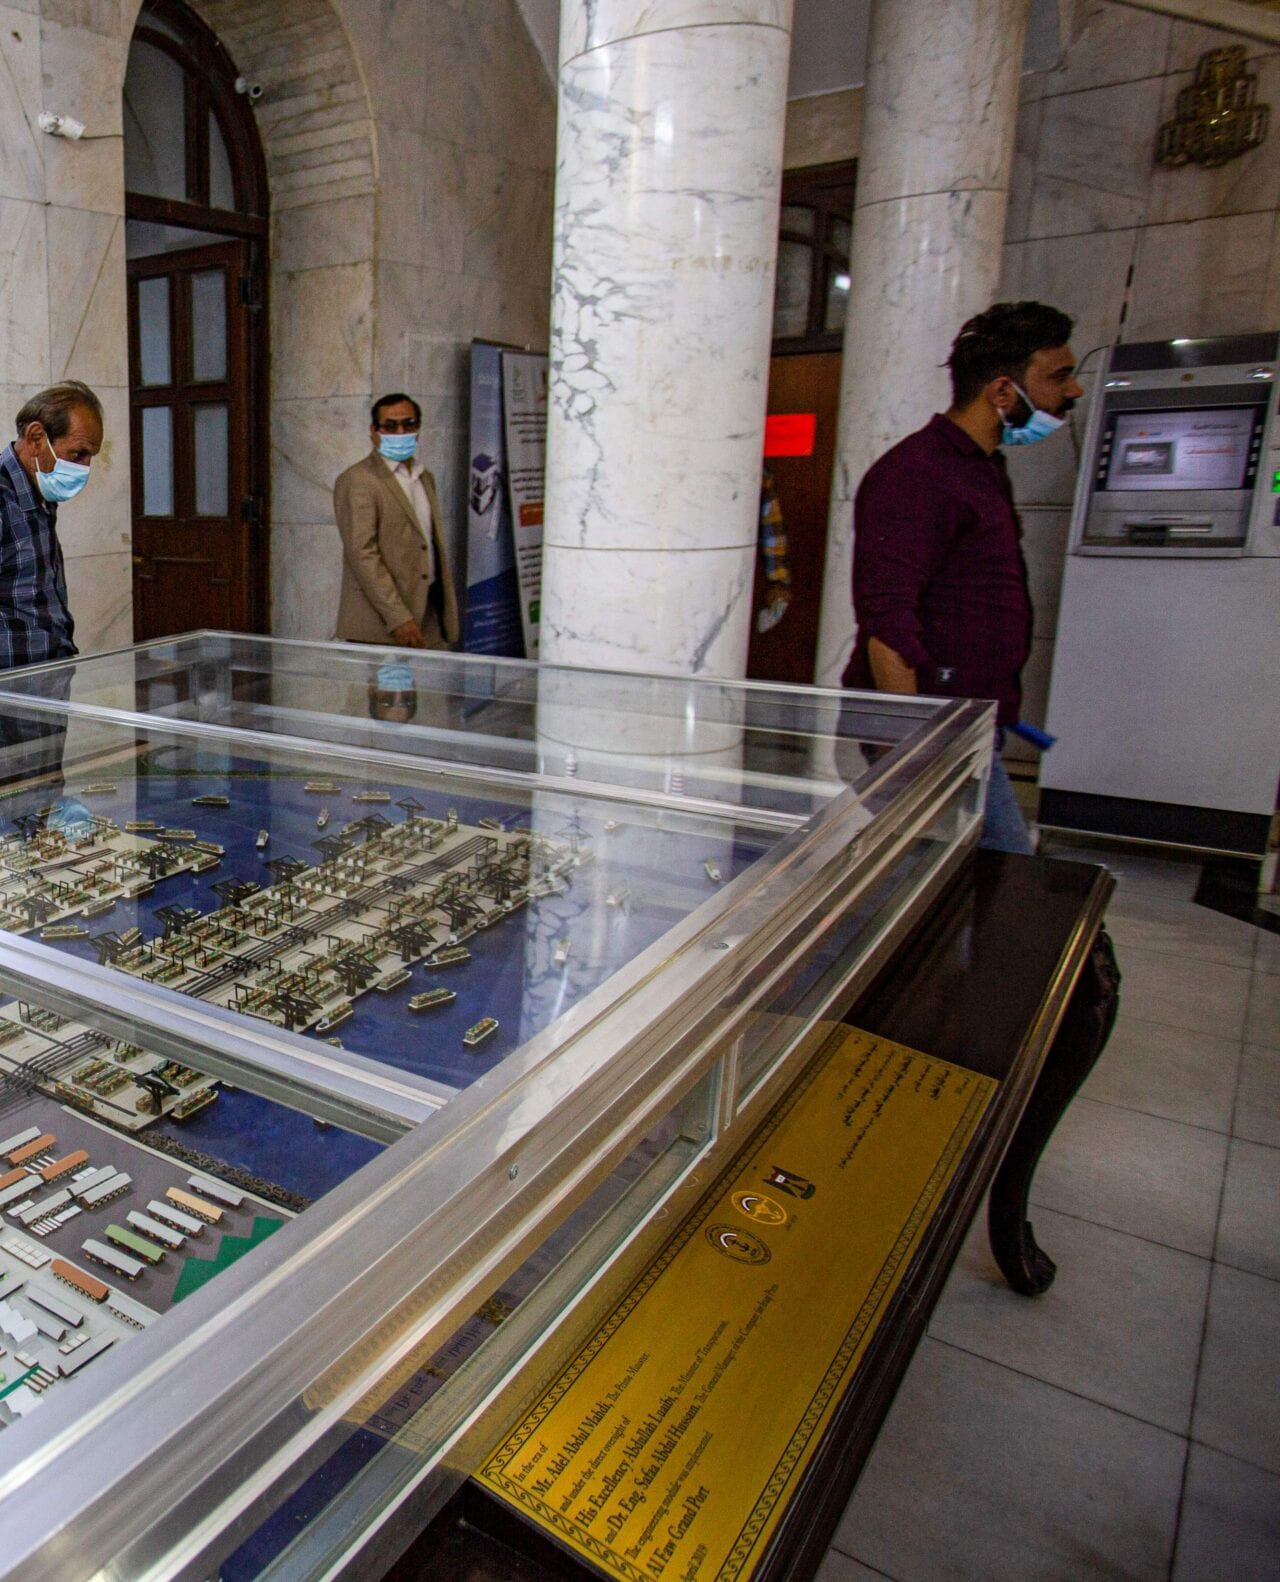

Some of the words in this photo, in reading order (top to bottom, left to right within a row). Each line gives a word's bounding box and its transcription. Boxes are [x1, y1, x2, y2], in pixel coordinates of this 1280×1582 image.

[512, 1472, 527, 1483] In
[521, 1461, 535, 1474] the
[531, 1451, 543, 1464] era
[538, 1441, 549, 1454] of
[531, 1478, 554, 1498] Mr.
[546, 1453, 571, 1480] Adel
[562, 1426, 591, 1459] Abdul
[581, 1401, 615, 1432] Mahdi,
[559, 1495, 573, 1513] and
[569, 1478, 586, 1499] under
[580, 1468, 595, 1481] the
[588, 1450, 607, 1470] direct
[603, 1424, 627, 1452] oversight
[621, 1414, 632, 1426] of
[574, 1507, 598, 1528] His
[588, 1459, 634, 1509] Excellency
[622, 1421, 658, 1463] Abdullah
[647, 1395, 679, 1424] Luaibi,
[651, 1434, 678, 1466] Abdul
[634, 1464, 660, 1490] Safaa
[618, 1490, 647, 1514] Eng.
[685, 1485, 710, 1510] Port
[606, 1512, 629, 1531] Dr.
[623, 1544, 642, 1560] The
[638, 1505, 670, 1547] engineering
[662, 1480, 682, 1508] module
[667, 1504, 697, 1540] Grand
[604, 1526, 618, 1545] and
[653, 1539, 677, 1564] Faw
[646, 1557, 665, 1578] Al
